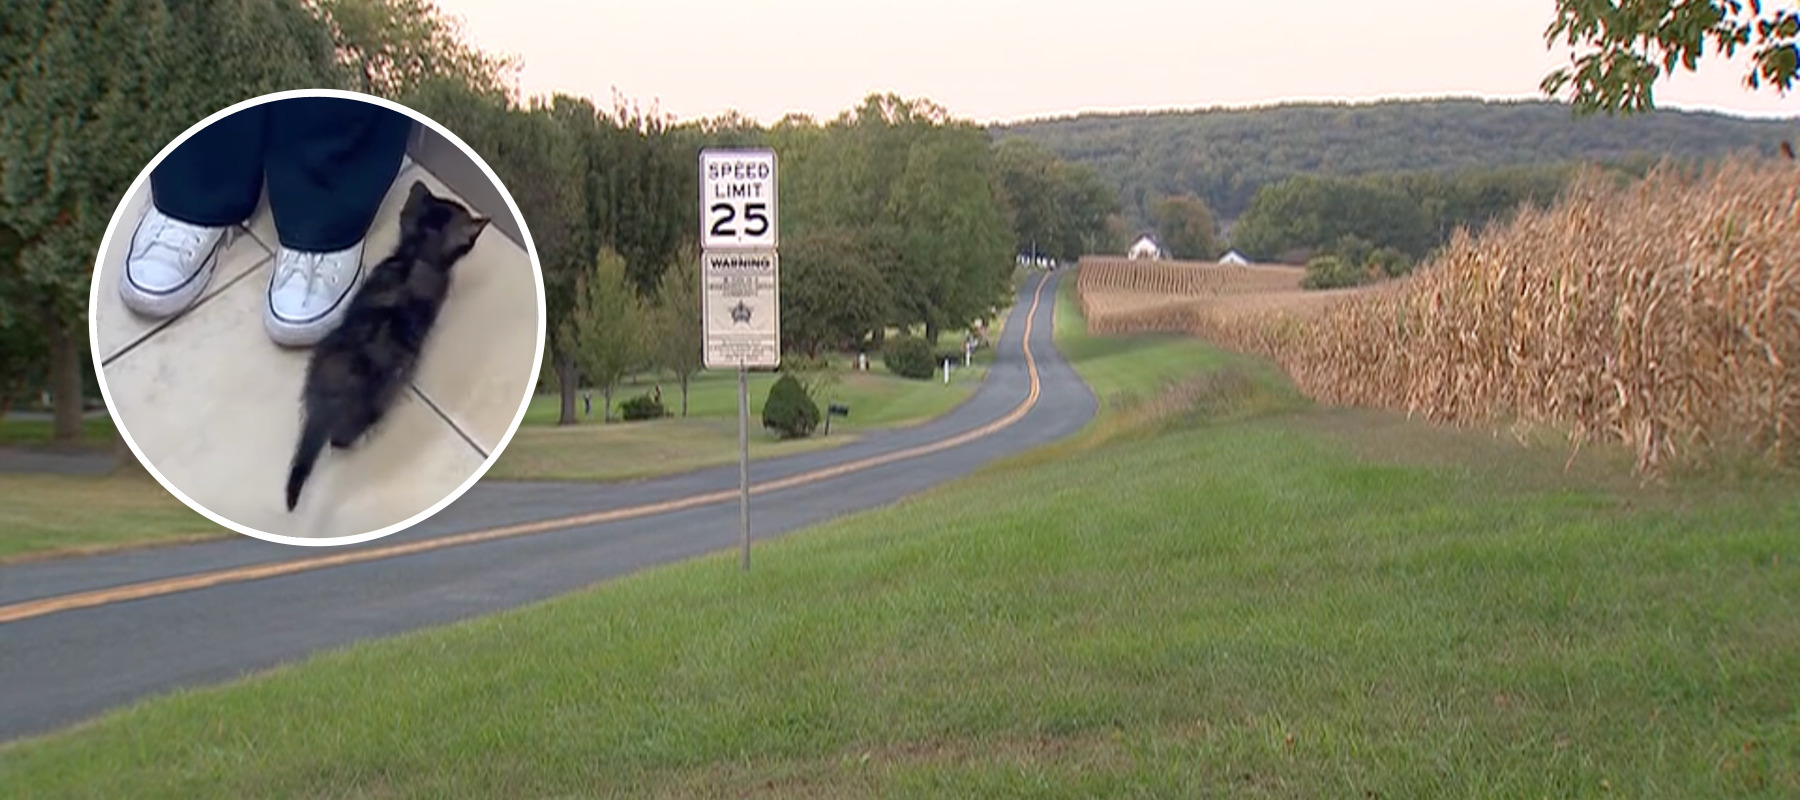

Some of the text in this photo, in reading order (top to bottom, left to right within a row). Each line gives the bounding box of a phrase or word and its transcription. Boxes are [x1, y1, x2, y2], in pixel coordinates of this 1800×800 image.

[709, 161, 770, 180] SPEED
[715, 183, 761, 198] LIMIT
[710, 203, 769, 236] 25
[710, 257, 771, 269] WARNING
